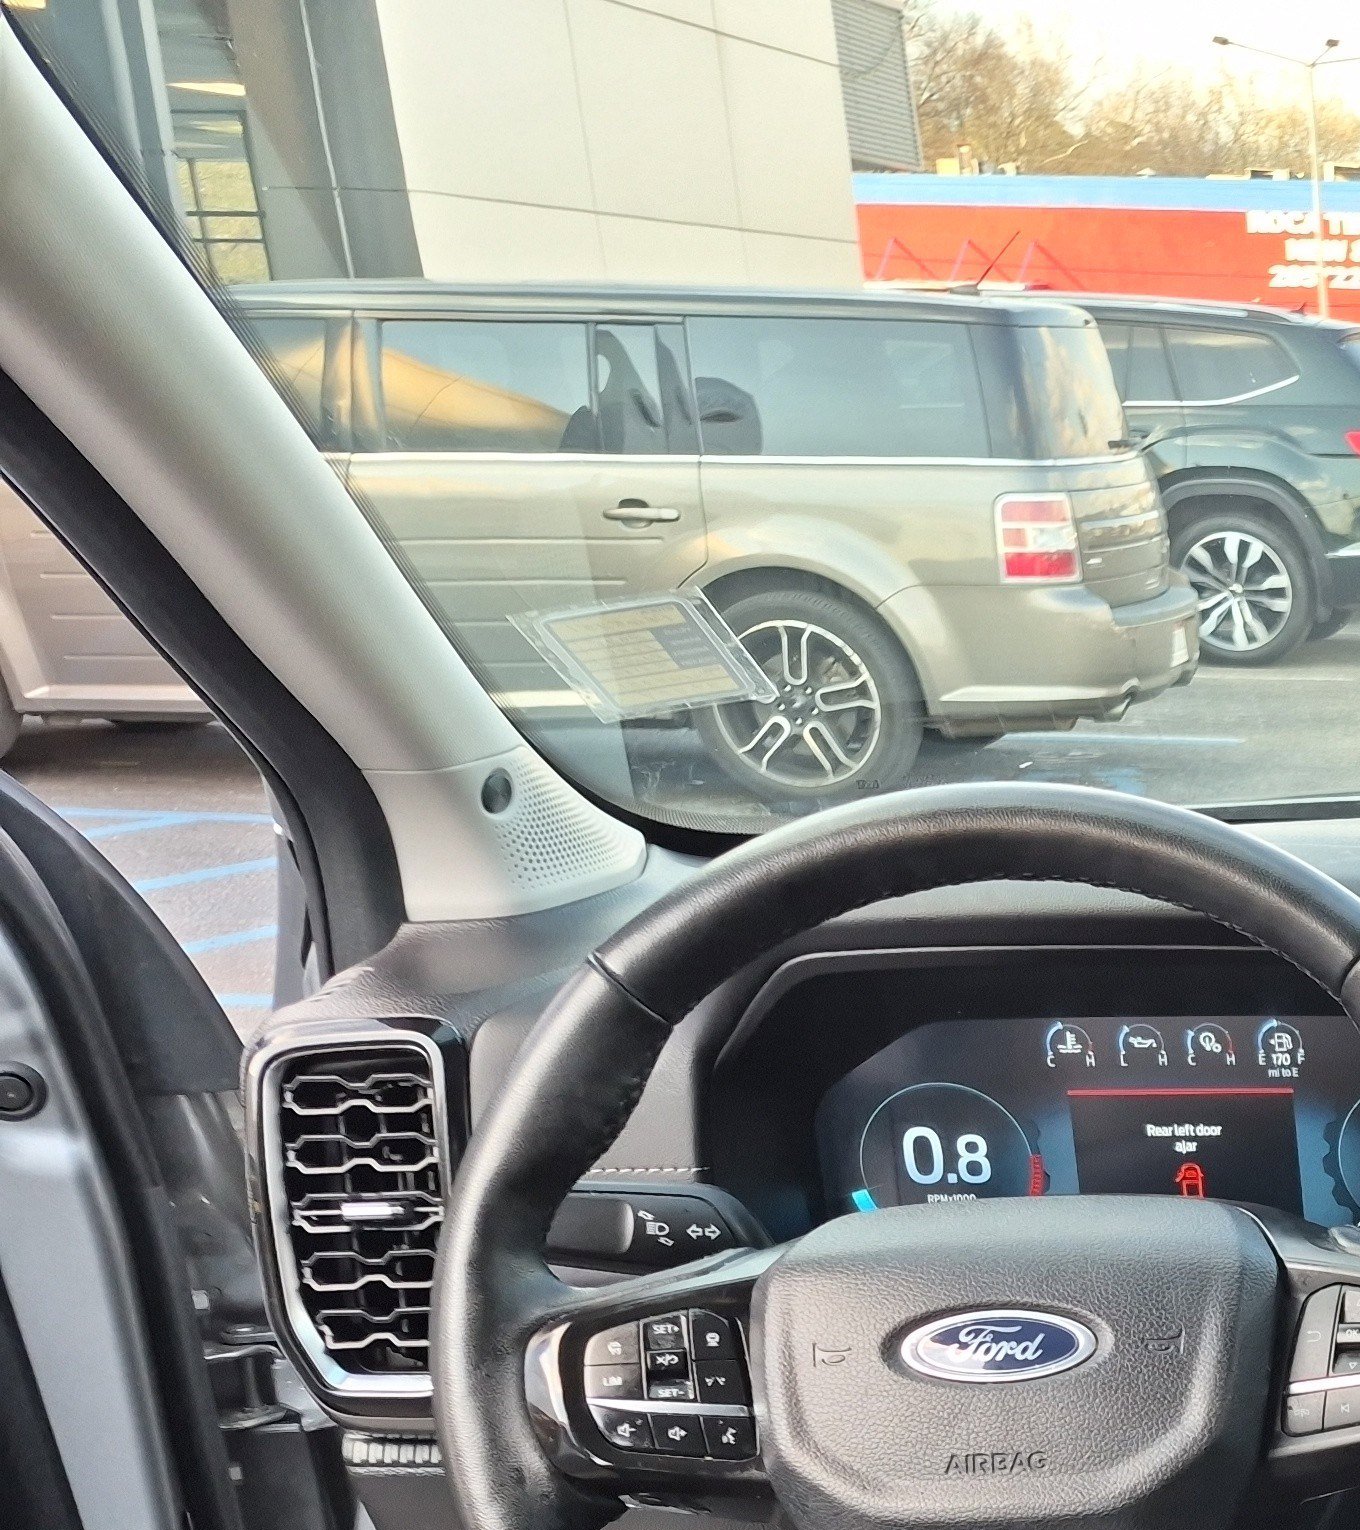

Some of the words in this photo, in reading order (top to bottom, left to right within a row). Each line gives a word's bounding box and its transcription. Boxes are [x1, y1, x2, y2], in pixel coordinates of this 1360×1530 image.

[1047, 1056, 1056, 1067] C
[1086, 1055, 1095, 1067] H
[1121, 1055, 1128, 1066] L
[1159, 1054, 1168, 1066] H
[1188, 1055, 1196, 1066] C
[1227, 1054, 1235, 1066] H
[1259, 1053, 1266, 1065] E
[1272, 1053, 1290, 1065] 170
[1268, 1068, 1280, 1078] mi
[1282, 1068, 1291, 1077] to
[1292, 1068, 1299, 1077] E
[1146, 1124, 1172, 1137] Rear
[1174, 1124, 1194, 1136] left
[1196, 1123, 1222, 1135] door
[1175, 1141, 1197, 1154] ajar
[902, 1126, 992, 1184] 0.8
[948, 1324, 1045, 1363] Ford
[944, 1451, 1049, 1475] AIRBAG
